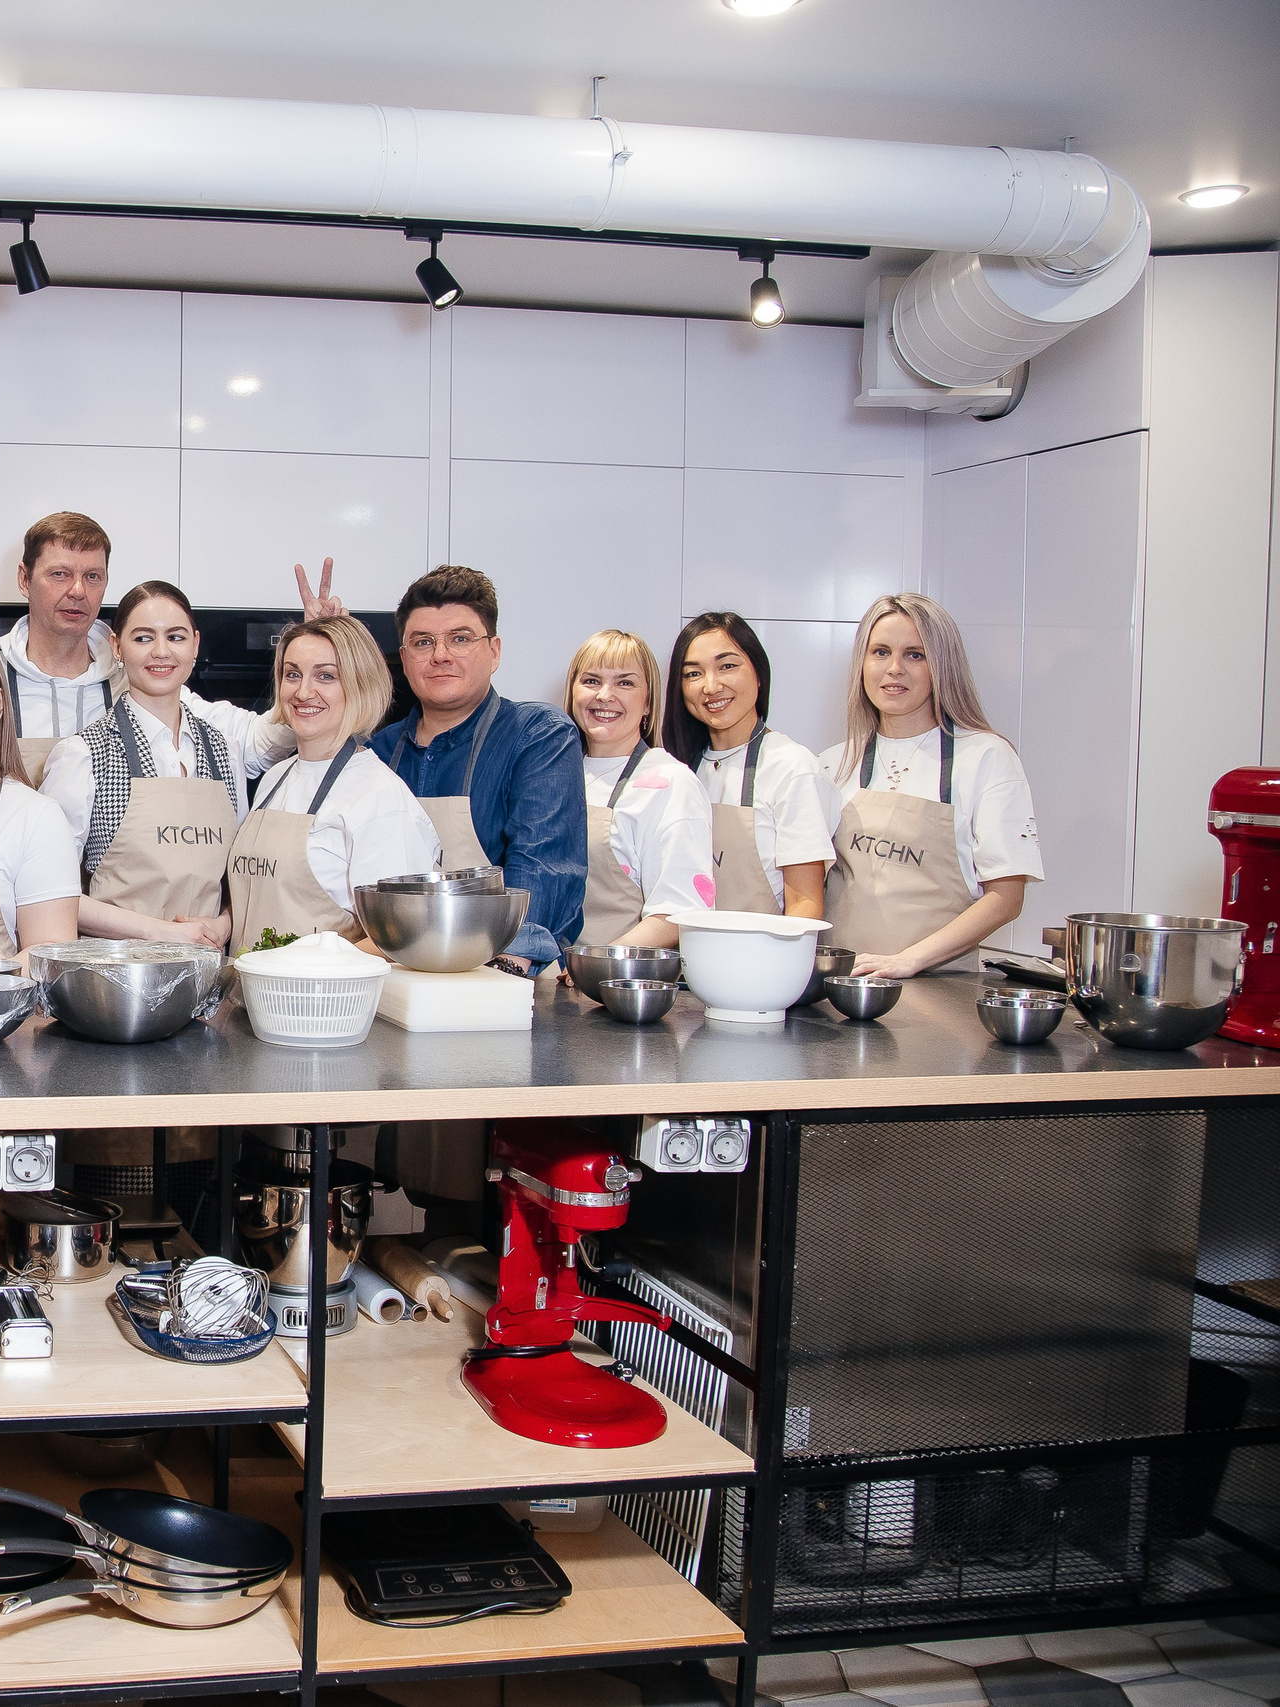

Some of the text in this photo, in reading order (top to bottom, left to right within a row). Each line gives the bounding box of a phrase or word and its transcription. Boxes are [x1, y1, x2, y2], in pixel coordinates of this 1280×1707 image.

[157, 826, 223, 845] KTCHN
[849, 833, 925, 866] KTCHN
[232, 855, 277, 878] KTCHN
